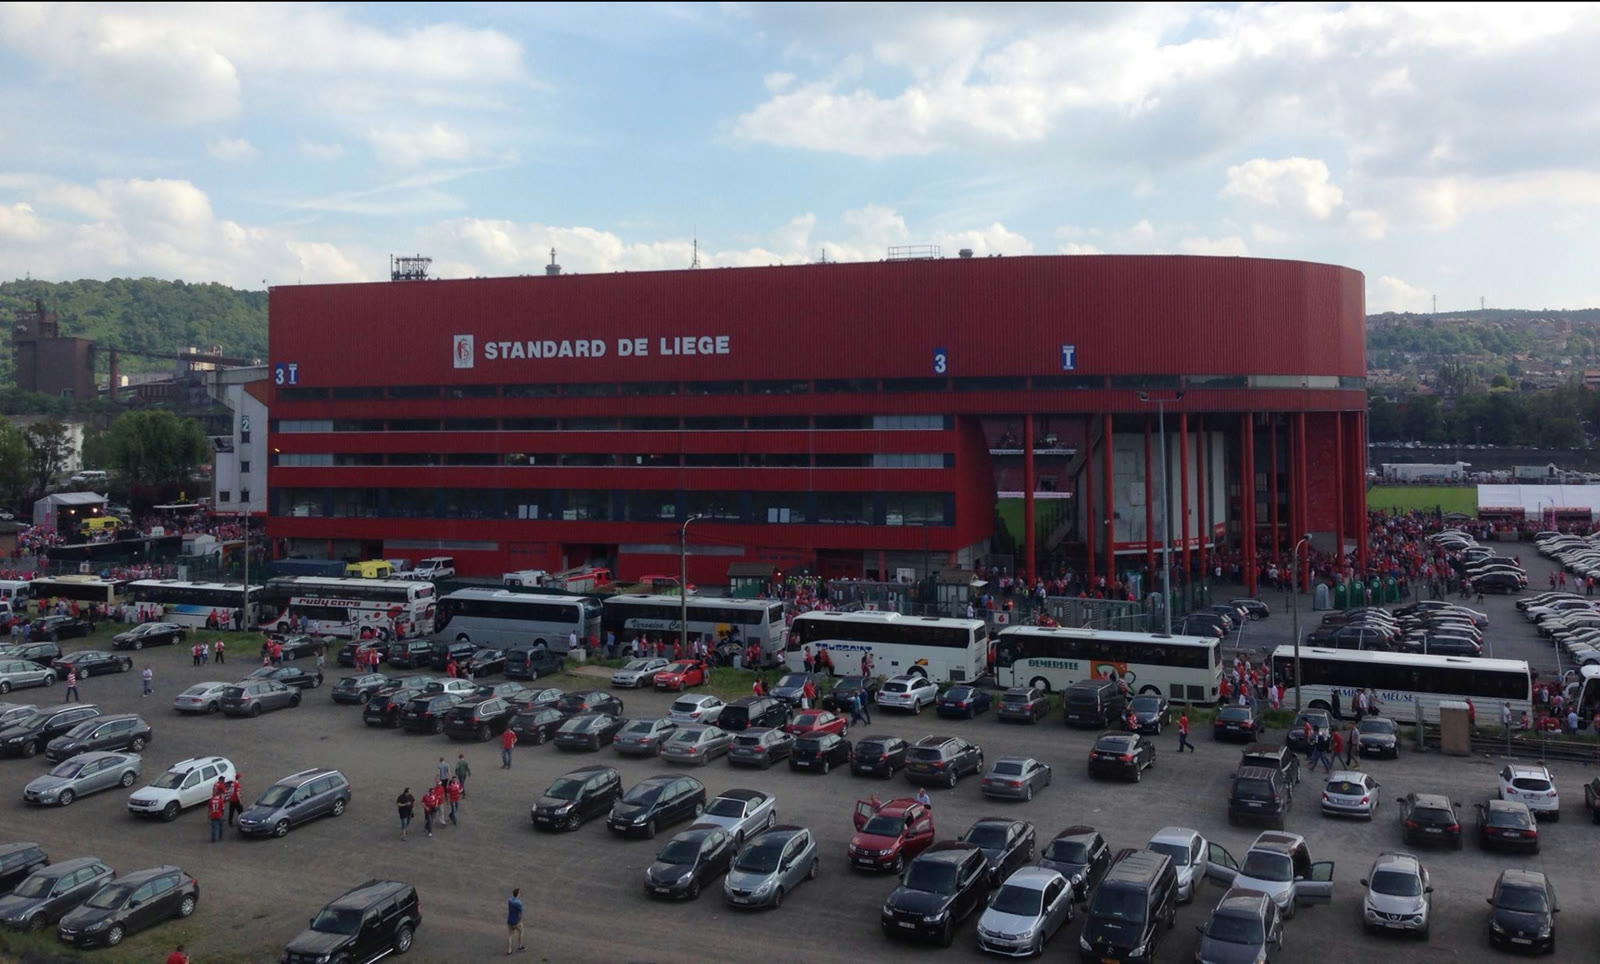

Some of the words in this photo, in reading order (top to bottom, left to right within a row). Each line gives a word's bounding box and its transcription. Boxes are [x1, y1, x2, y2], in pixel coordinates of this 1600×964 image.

[484, 339, 606, 359] STANDARD
[618, 338, 648, 356] DE
[660, 335, 730, 355] LIEGE
[934, 353, 947, 373] 3
[275, 368, 285, 385] 3
[242, 418, 250, 432] 2
[1382, 691, 1415, 702] MEUSE
